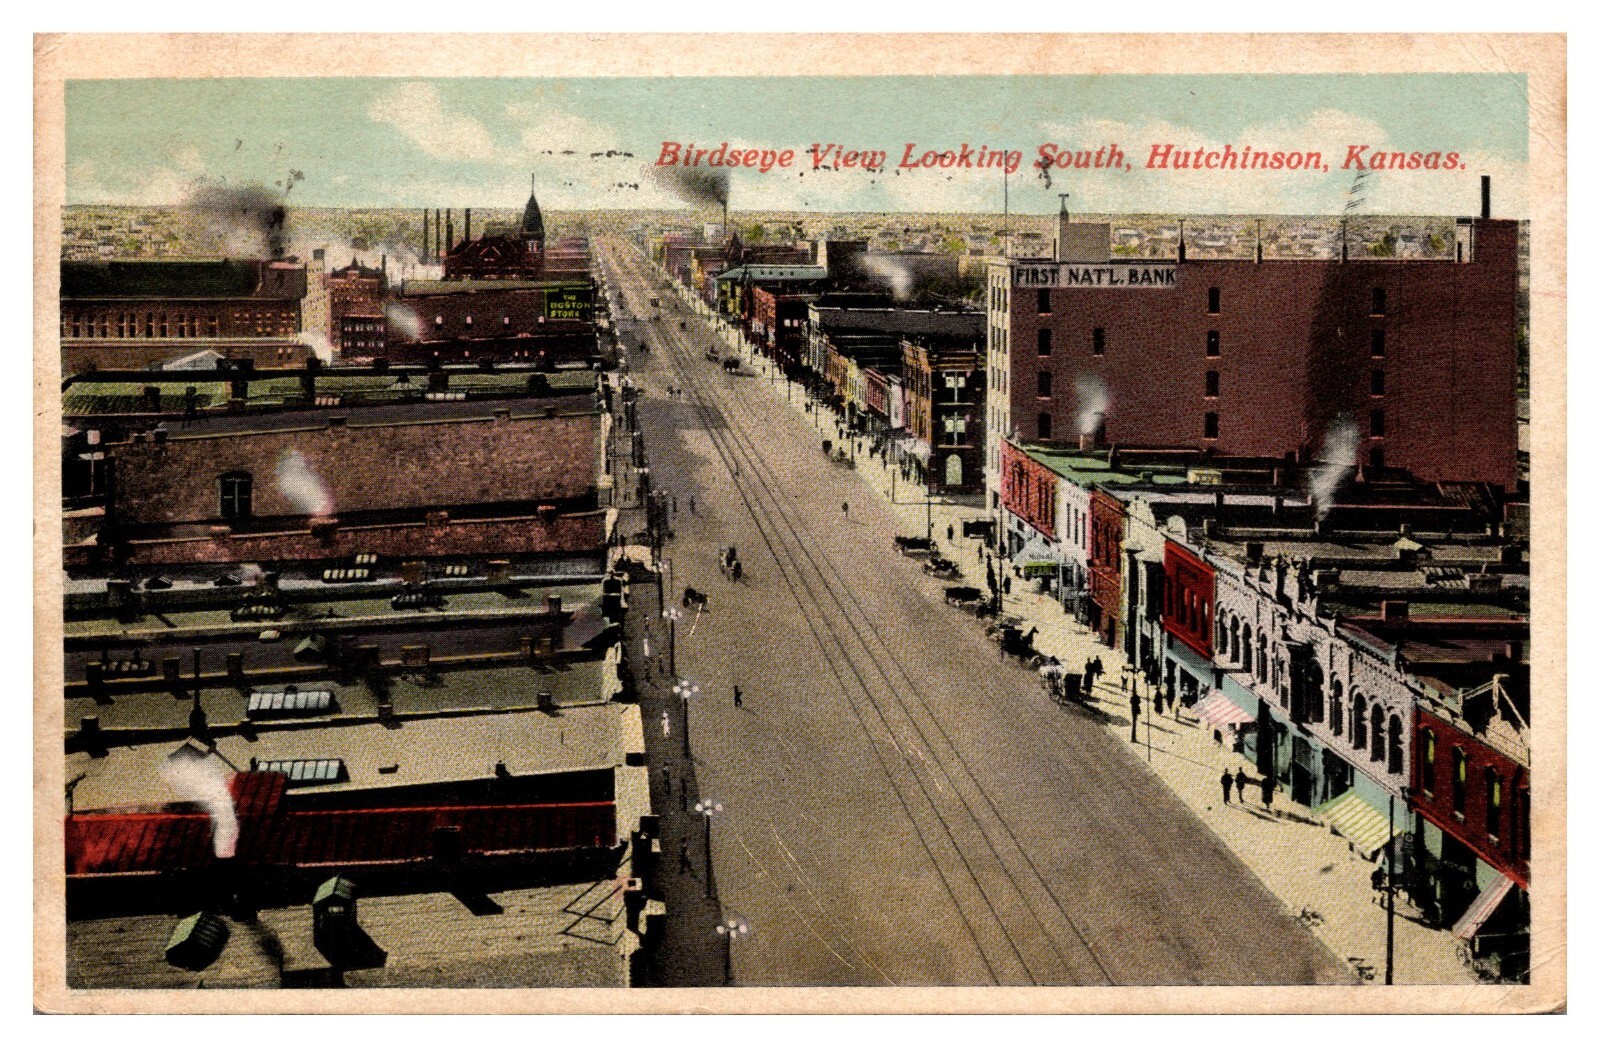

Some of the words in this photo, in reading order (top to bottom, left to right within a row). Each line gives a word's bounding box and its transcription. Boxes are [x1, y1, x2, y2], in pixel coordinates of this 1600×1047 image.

[1015, 268, 1059, 285] FIRST
[1128, 268, 1176, 285] BANK
[550, 301, 591, 309] BOSTON
